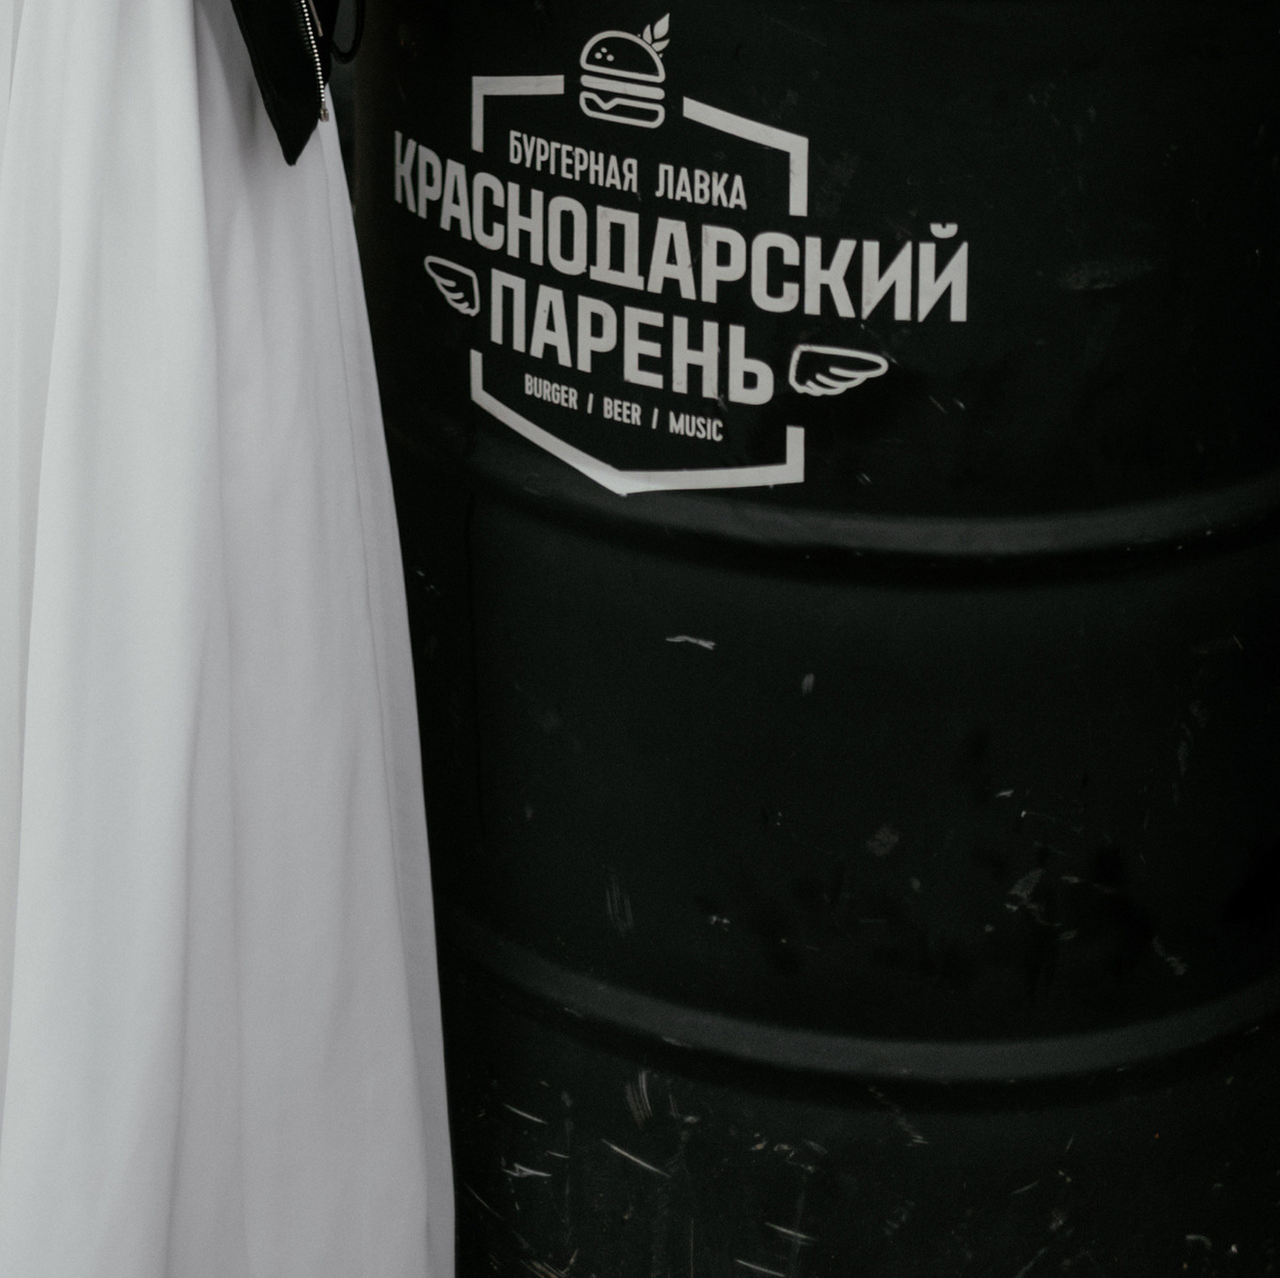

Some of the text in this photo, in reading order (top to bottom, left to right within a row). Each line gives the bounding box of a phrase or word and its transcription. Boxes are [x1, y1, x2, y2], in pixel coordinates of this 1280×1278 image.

[509, 130, 747, 210] БУРГЕРНАЯ ЛАВКА
[394, 130, 969, 323] КРАСНОДАРСКИЙ
[490, 268, 775, 406] ПАРЕНЬ
[524, 373, 578, 411] BURGER
[602, 399, 642, 427] BEER
[669, 412, 723, 442] MUSIC
